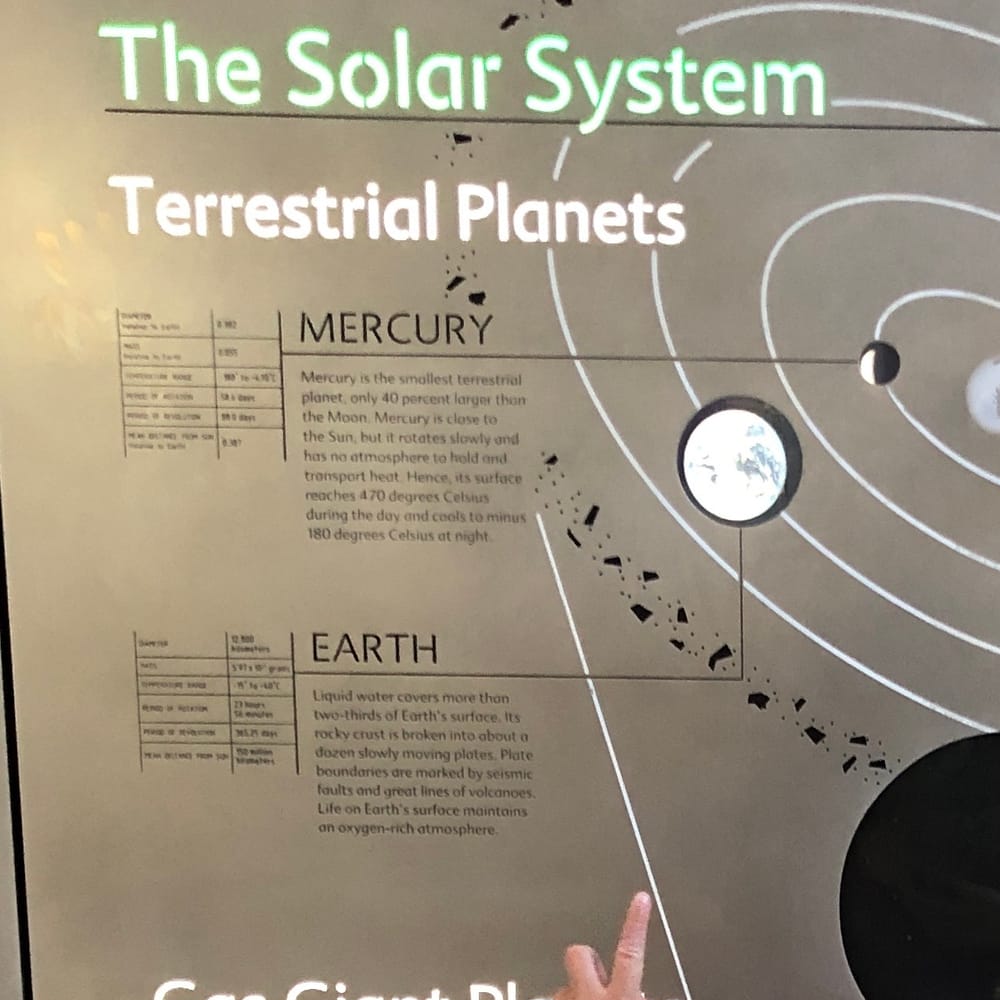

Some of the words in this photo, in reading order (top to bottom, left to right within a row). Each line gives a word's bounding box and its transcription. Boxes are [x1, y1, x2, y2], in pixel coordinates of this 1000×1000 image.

[99, 22, 261, 105] The
[286, 28, 502, 111] Solar
[525, 33, 827, 134] System
[108, 175, 438, 241] Terrestrial
[457, 180, 686, 245] Planets
[300, 312, 494, 344] MERCURY
[301, 371, 355, 387] Mercury
[360, 372, 370, 384] is
[373, 372, 395, 384] the
[399, 372, 452, 385] smallest
[457, 373, 521, 385] terrestrial
[305, 489, 355, 501] reaches
[360, 489, 385, 502] 470
[388, 490, 439, 506] degrees
[443, 490, 489, 503] Celsius
[311, 632, 438, 664] EARTH
[312, 689, 352, 705] Liquid
[356, 690, 394, 702] water
[397, 693, 439, 703] covers
[442, 694, 475, 703] more
[479, 691, 509, 703] than
[315, 746, 355, 758] dozen
[358, 746, 399, 762] slowly
[402, 747, 450, 763] moving
[454, 747, 496, 763] plates.
[500, 748, 533, 760] Plate
[318, 802, 341, 814] Life
[345, 805, 361, 814] on
[364, 802, 409, 815] Earth's
[413, 803, 459, 815] surface
[463, 803, 527, 816] maintains
